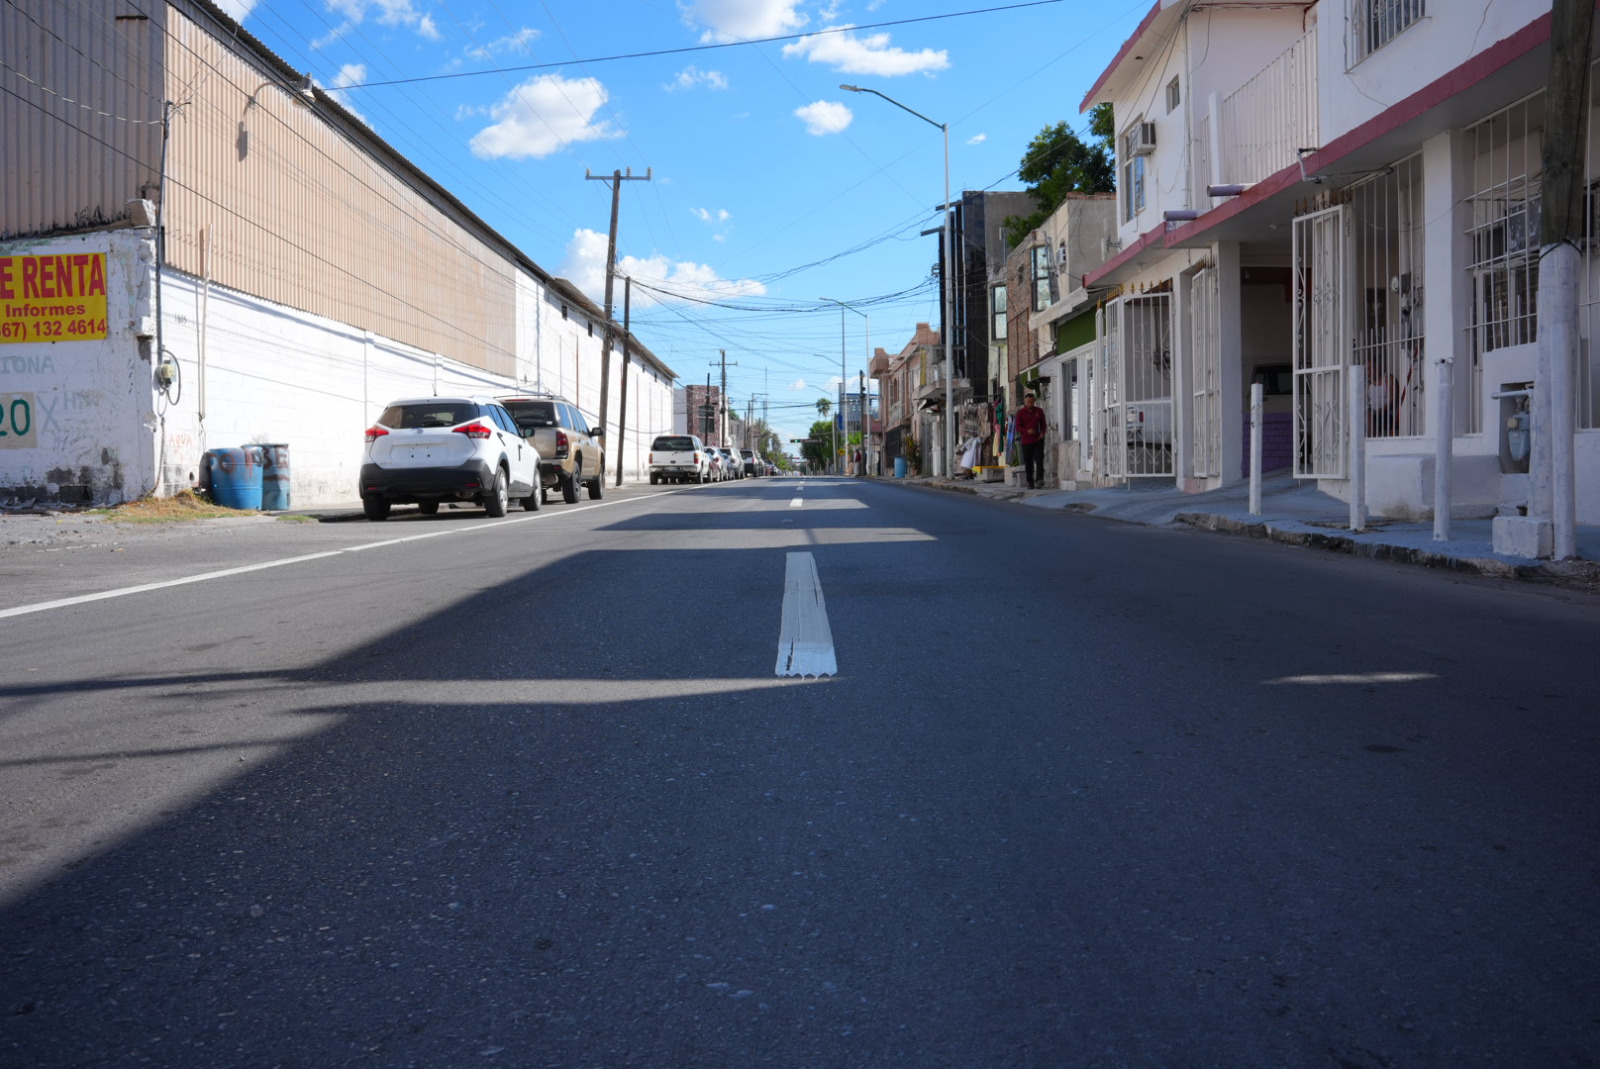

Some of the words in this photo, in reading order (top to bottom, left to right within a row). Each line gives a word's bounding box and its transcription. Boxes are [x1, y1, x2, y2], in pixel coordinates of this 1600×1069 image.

[0, 257, 15, 300] E
[22, 254, 106, 299] RENTA
[5, 303, 86, 318] Informes
[0, 321, 27, 341] 67)
[33, 320, 63, 336] 132
[67, 318, 106, 335] 4614
